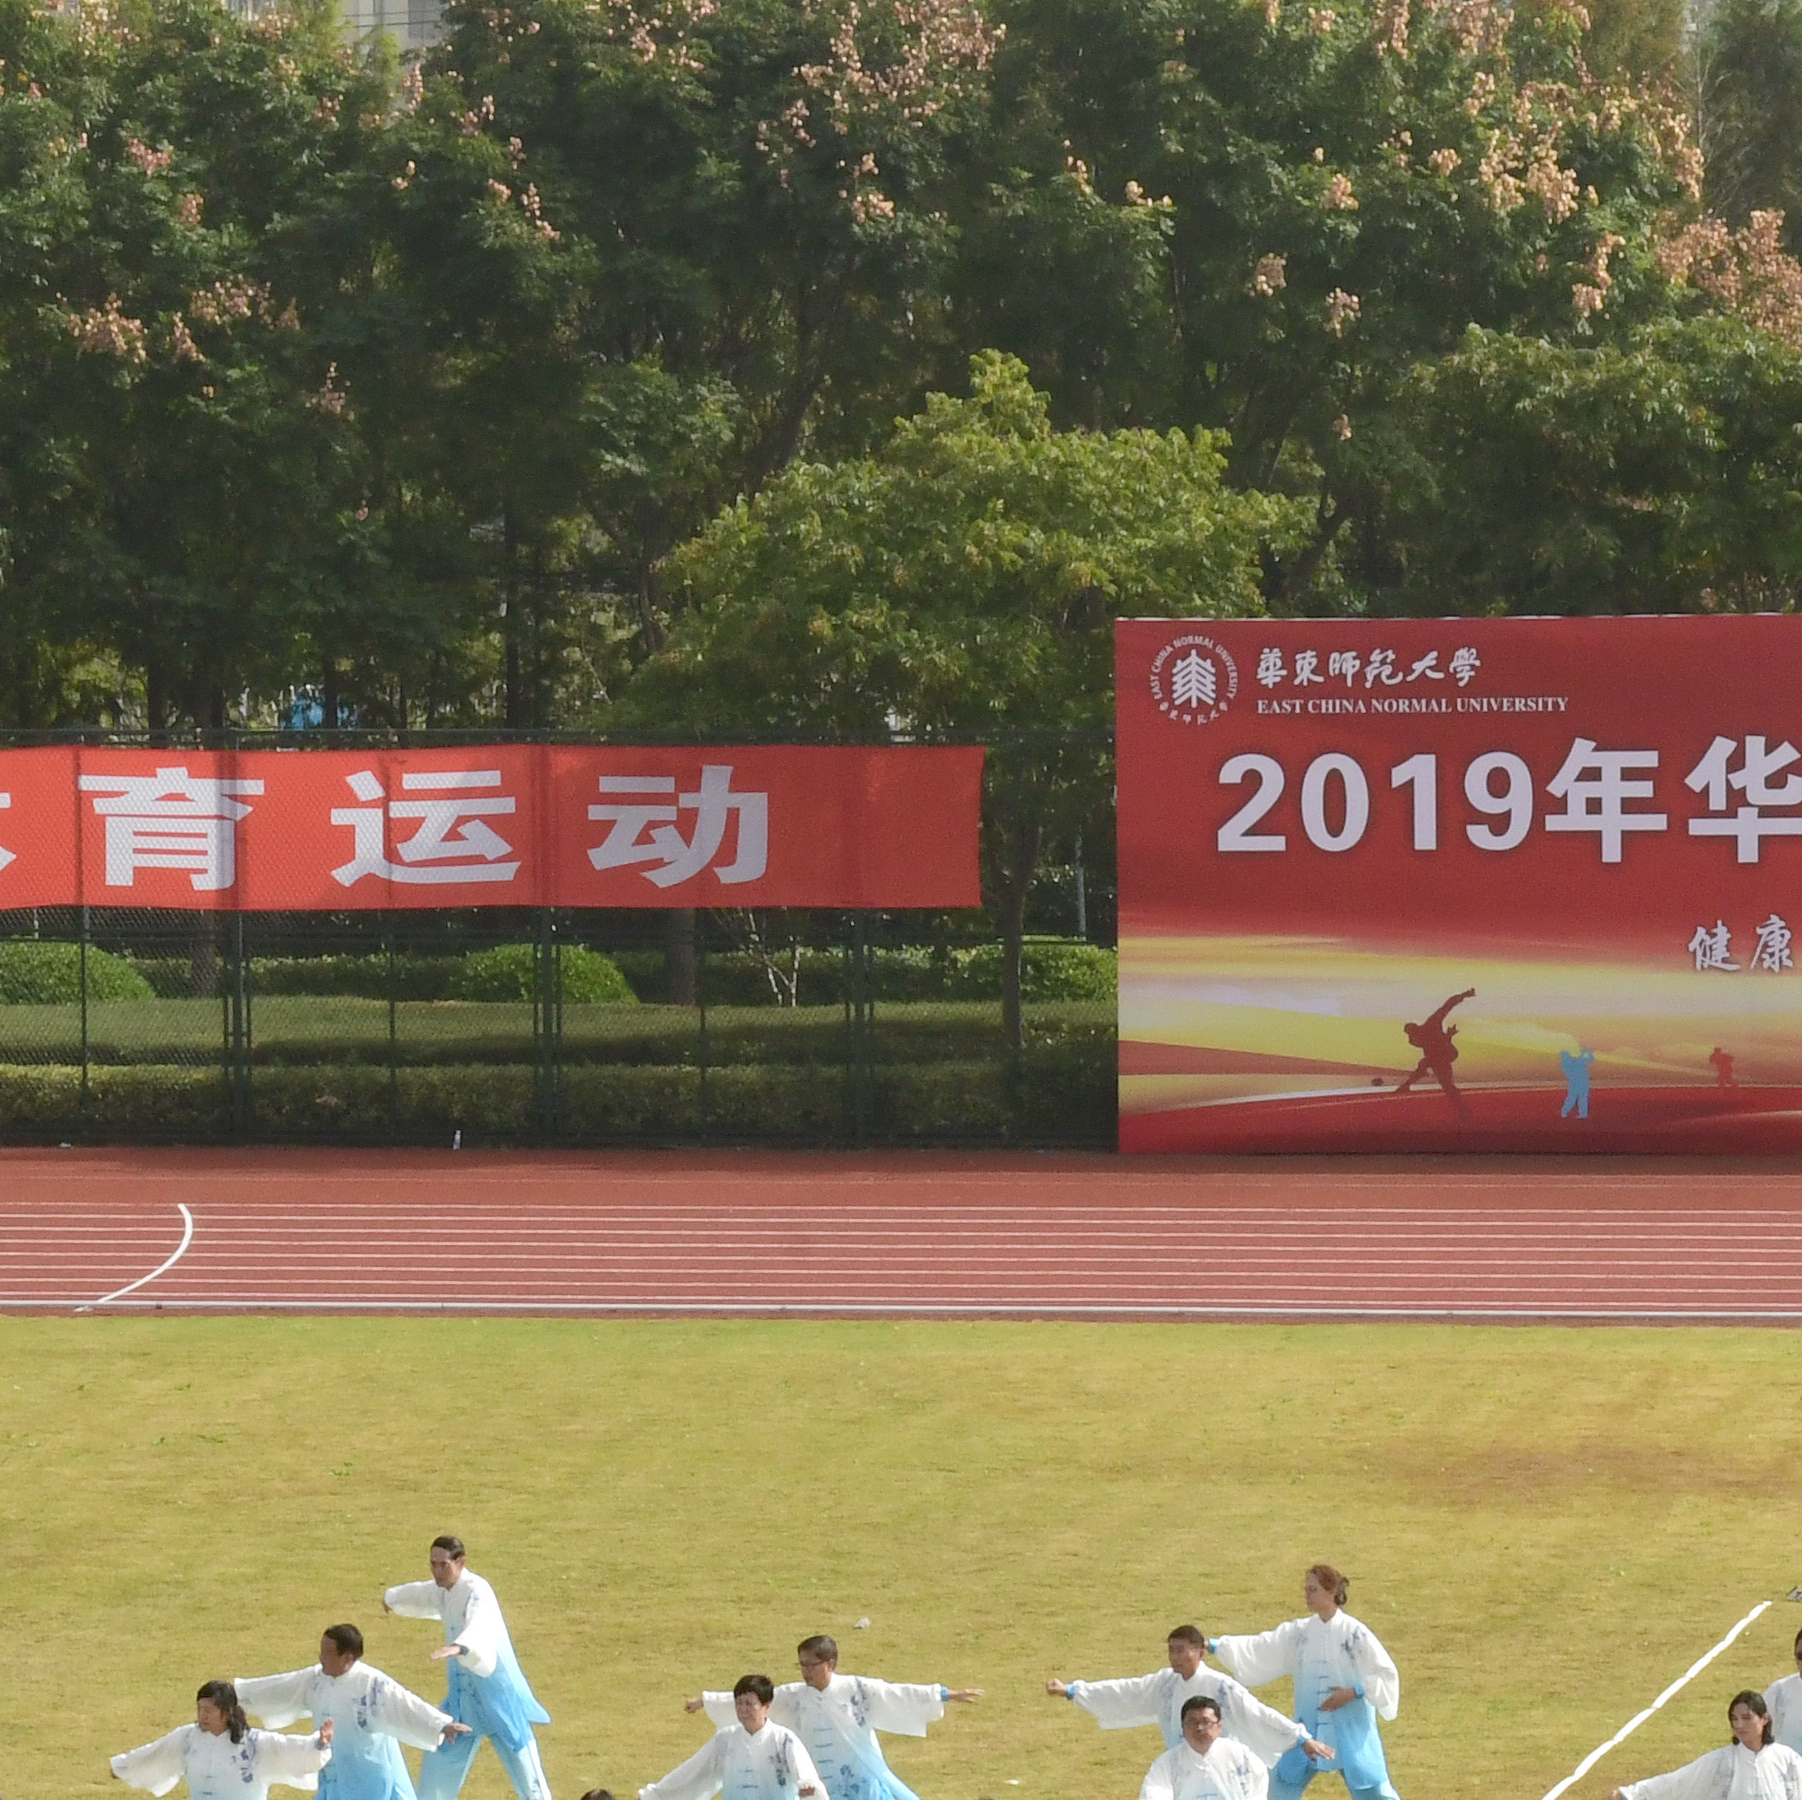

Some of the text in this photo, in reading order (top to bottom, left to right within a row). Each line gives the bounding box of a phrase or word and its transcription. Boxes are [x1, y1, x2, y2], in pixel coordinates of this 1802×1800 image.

[1257, 696, 1569, 714] EAST CHINA NORMAL UNIVERSITY
